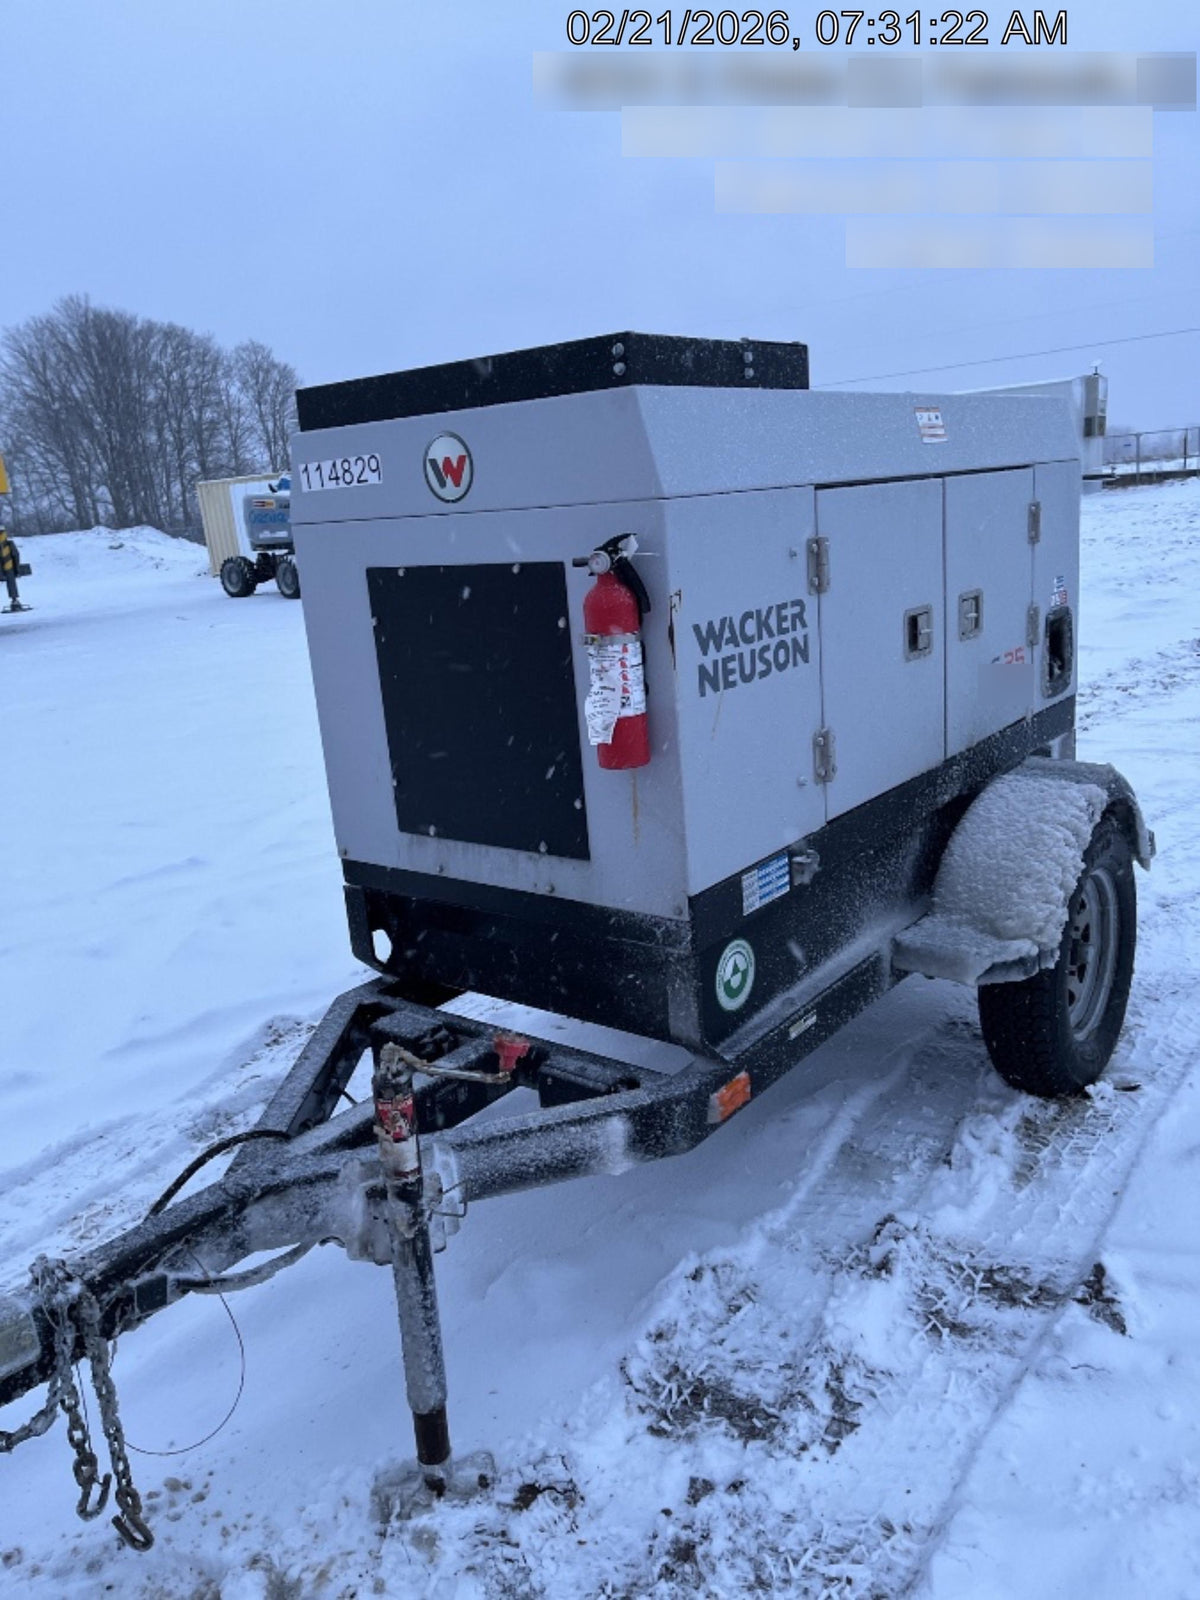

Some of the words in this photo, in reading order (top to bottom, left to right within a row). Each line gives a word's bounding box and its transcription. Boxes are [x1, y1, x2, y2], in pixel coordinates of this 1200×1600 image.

[302, 454, 381, 490] 114829
[692, 598, 808, 657] WACKER
[697, 633, 810, 698] NEUSON
